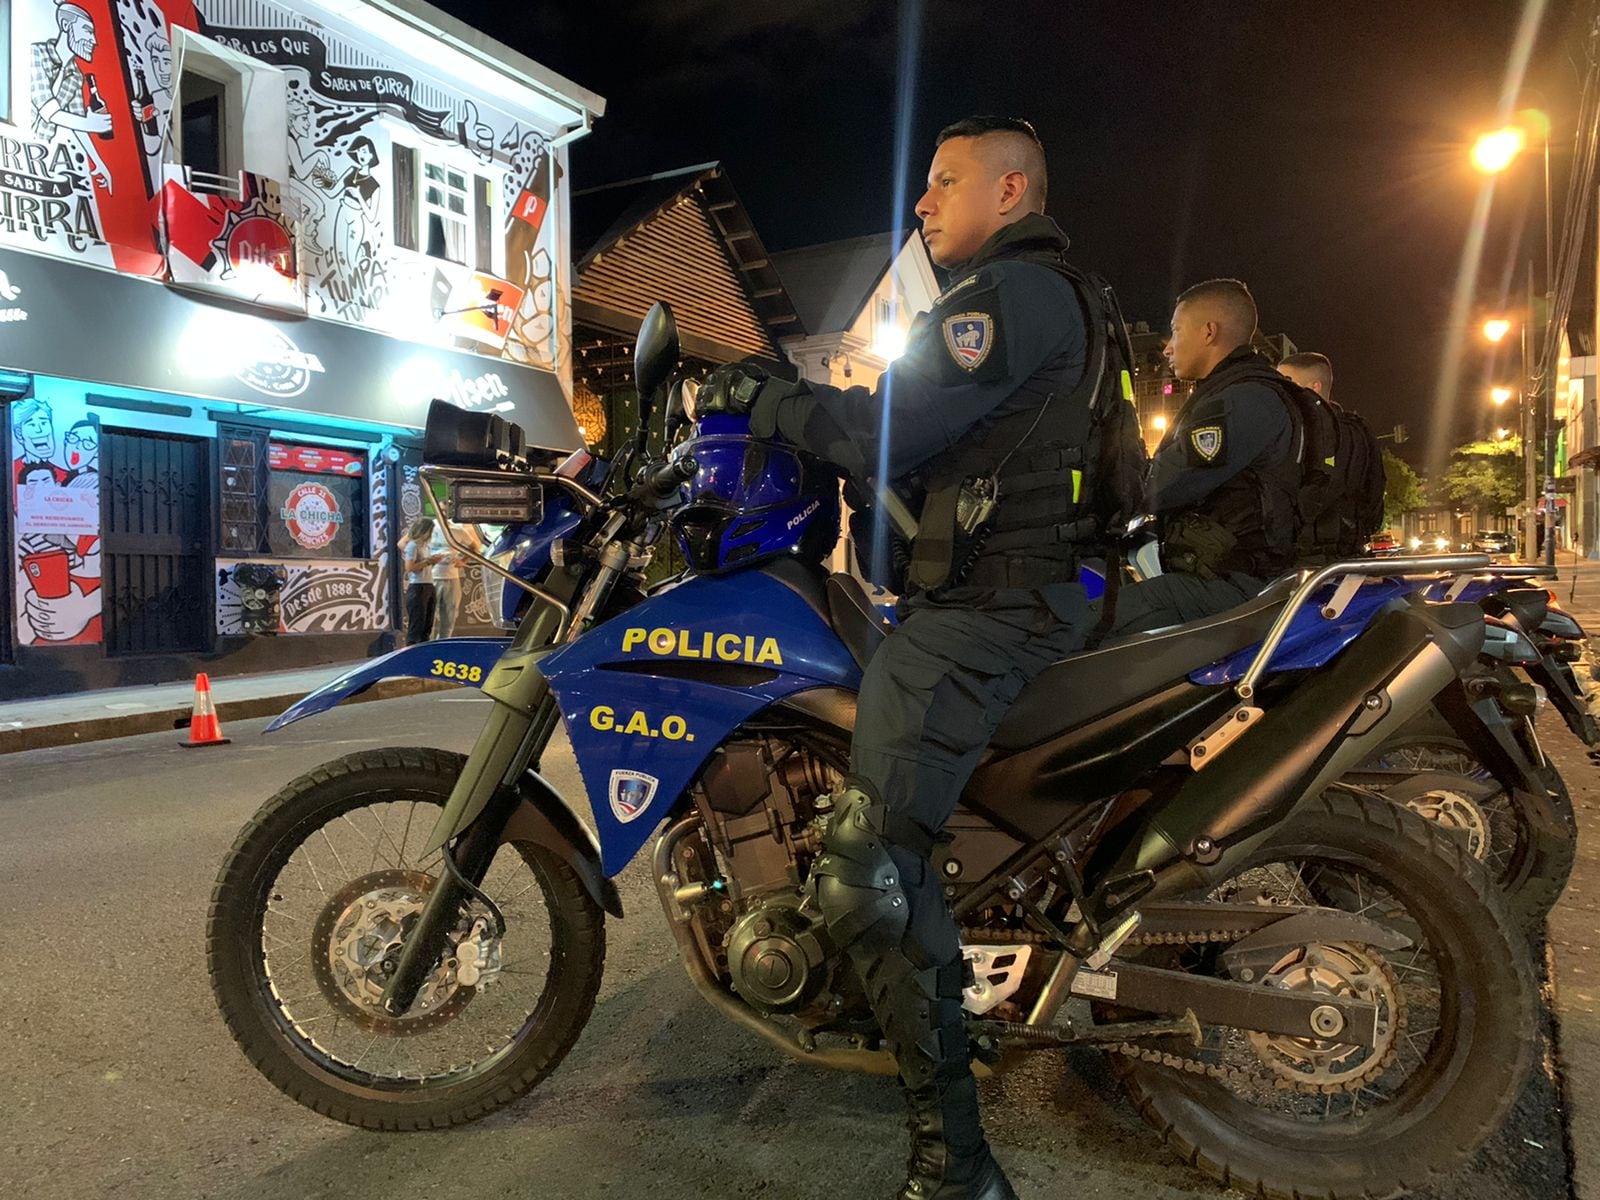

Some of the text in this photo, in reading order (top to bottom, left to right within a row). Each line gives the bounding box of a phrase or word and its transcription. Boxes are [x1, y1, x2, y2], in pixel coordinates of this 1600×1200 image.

[251, 39, 278, 55] LOS
[280, 36, 310, 56] QUE
[320, 71, 410, 102] SABEN DE BIRRA
[4, 173, 61, 195] SABE A
[0, 190, 107, 253] IRRA
[320, 257, 388, 309] TUMPA
[281, 508, 344, 523] LA CHICHA
[787, 500, 820, 530] POLICIA
[285, 583, 353, 617] Desde 1888
[622, 628, 783, 665] POLICIA
[431, 659, 482, 682] 3638
[590, 705, 695, 742] G.A.O.
